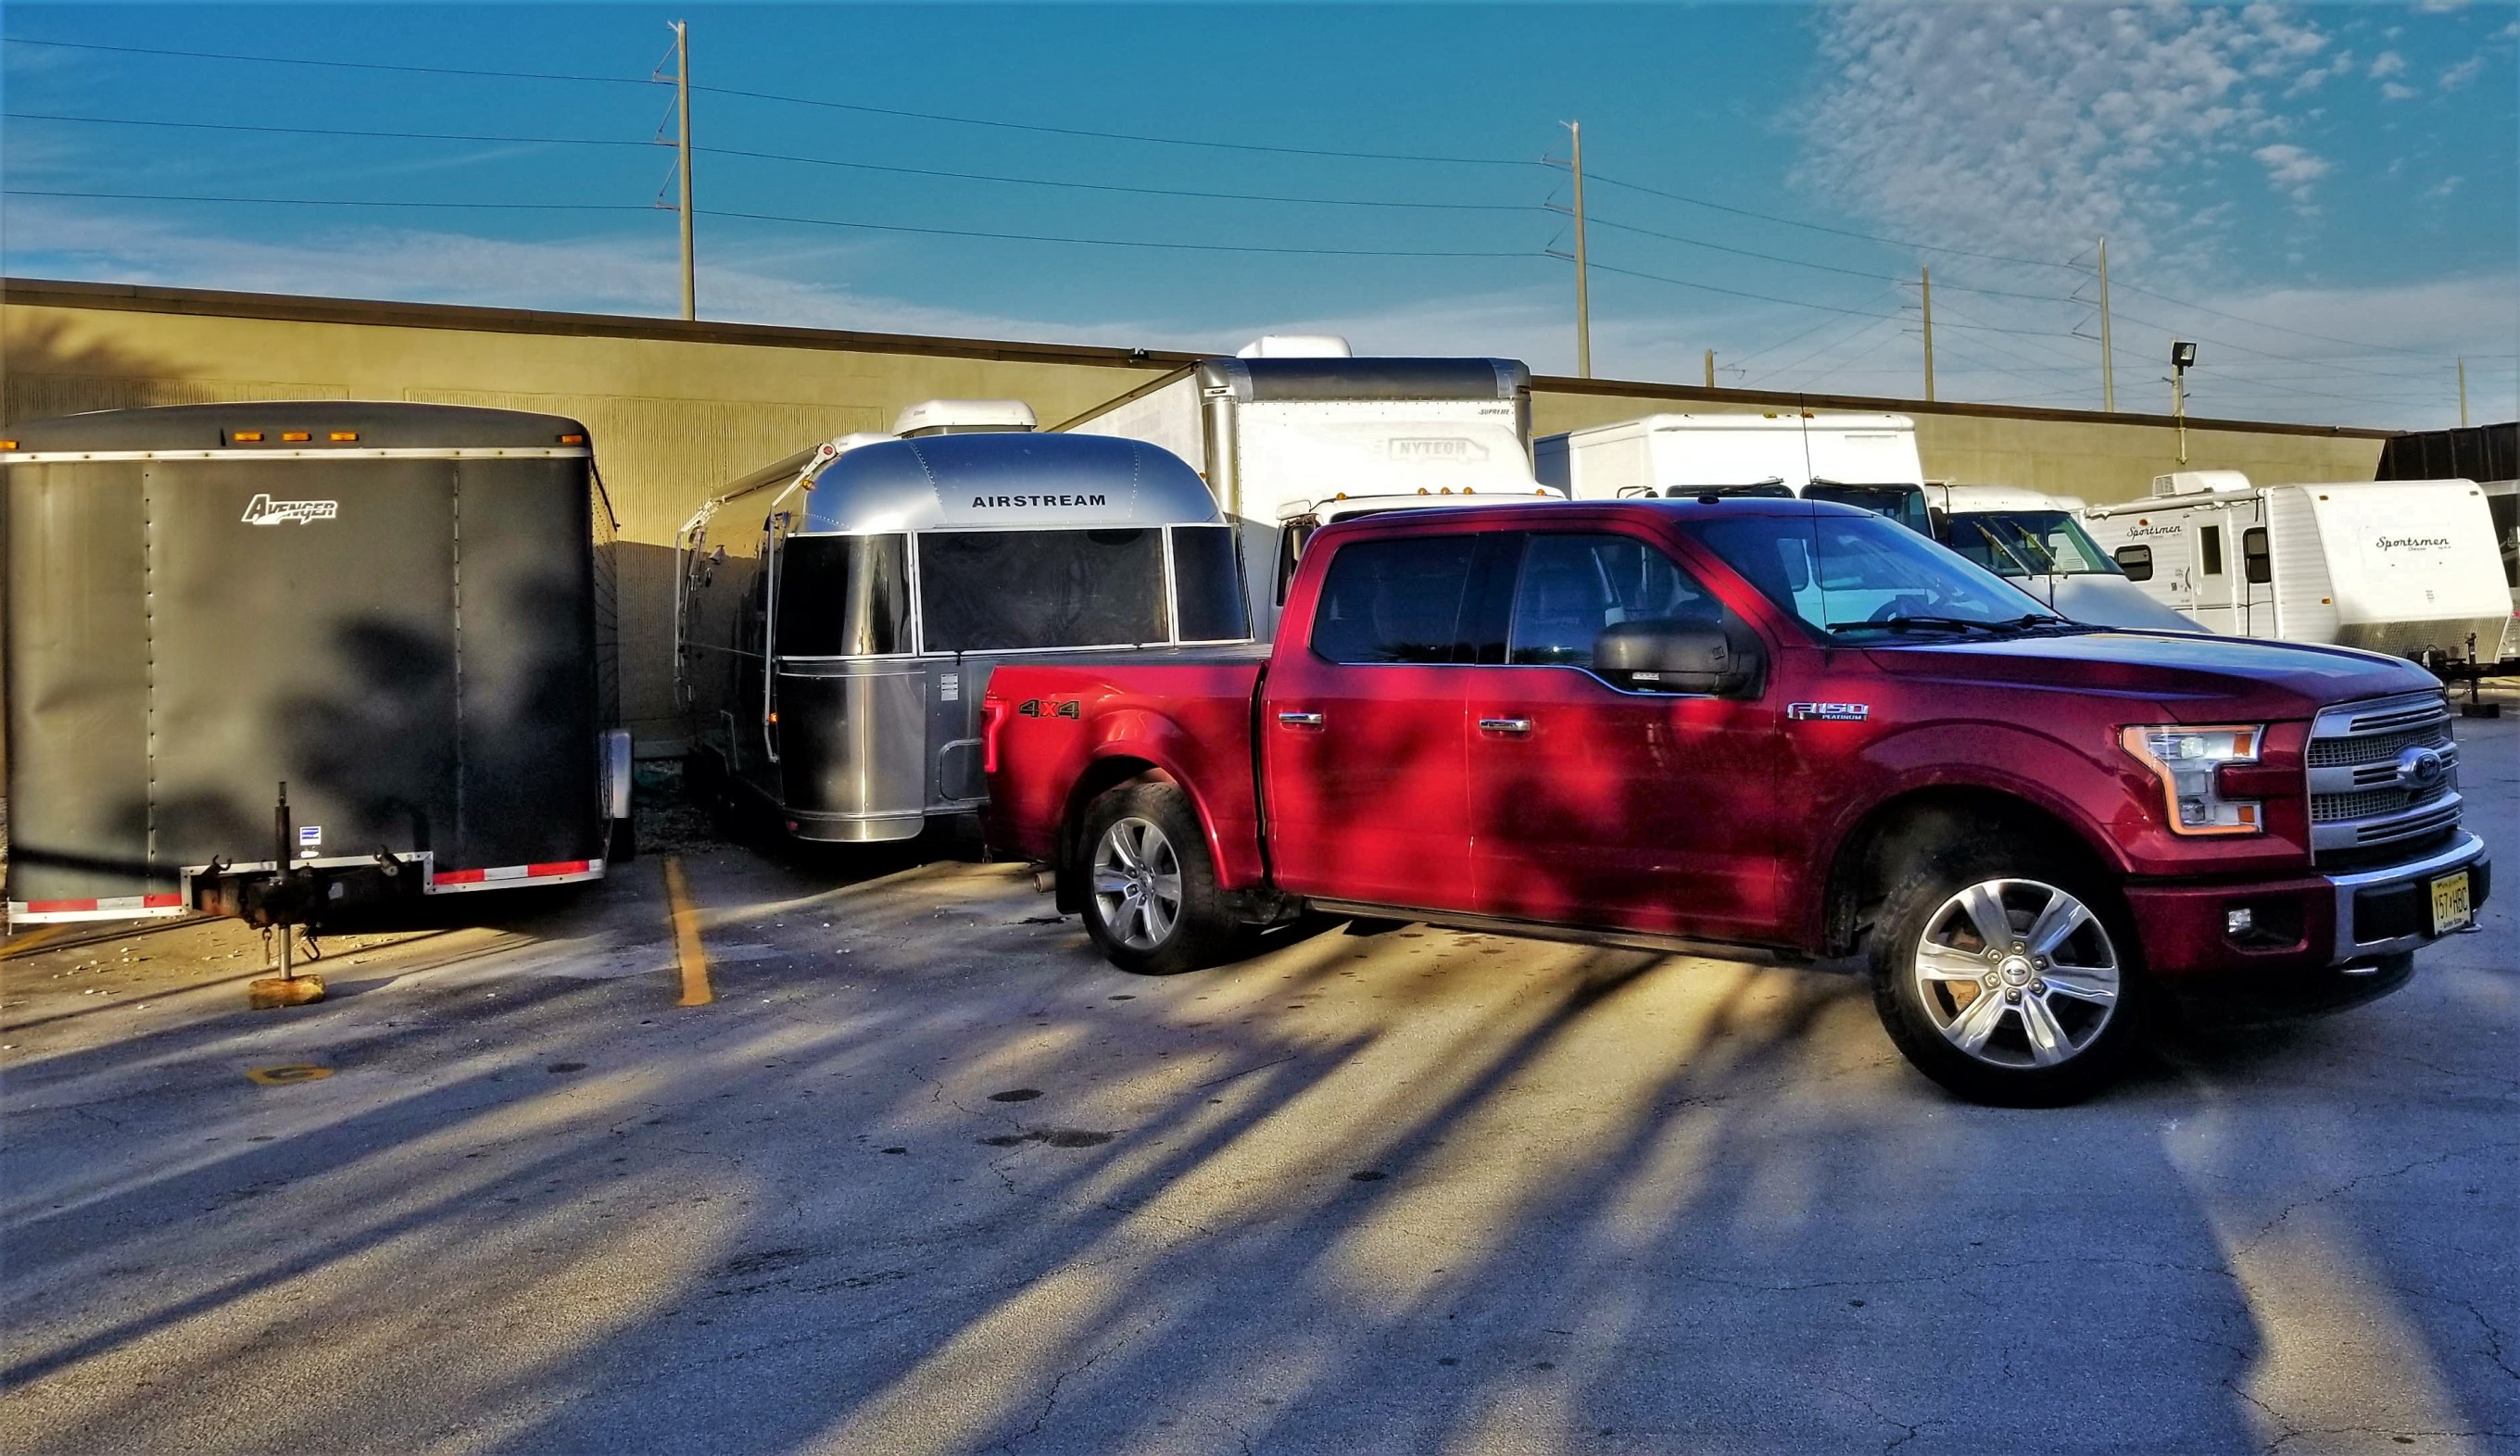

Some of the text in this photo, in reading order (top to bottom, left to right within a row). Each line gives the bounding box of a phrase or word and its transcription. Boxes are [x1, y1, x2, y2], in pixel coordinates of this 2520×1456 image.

[972, 495, 1106, 508] AIRSTREAM
[2126, 525, 2181, 541] Sportsmen
[2375, 536, 2450, 552] Sportsmen
